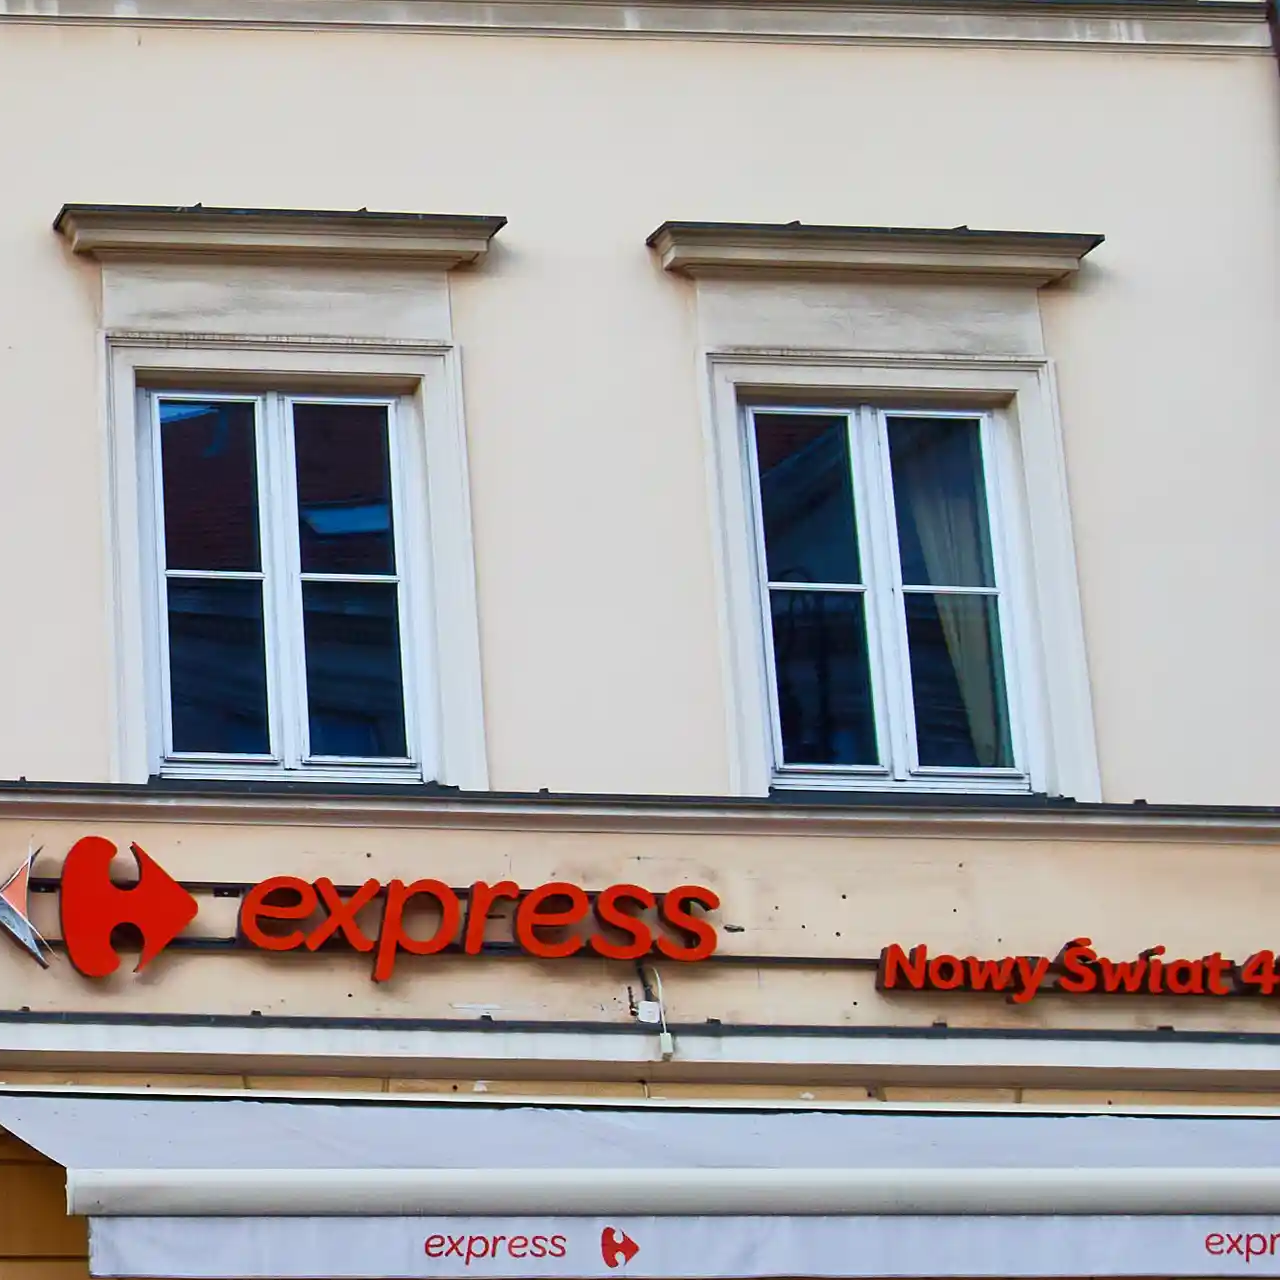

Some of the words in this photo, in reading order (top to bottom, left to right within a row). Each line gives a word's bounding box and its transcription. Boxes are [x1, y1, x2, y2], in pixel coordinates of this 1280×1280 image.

[240, 876, 720, 982] express
[877, 943, 1049, 1004] Nowy
[1058, 937, 1230, 995] Świat
[1241, 949, 1280, 995] 4
[424, 1234, 567, 1266] express
